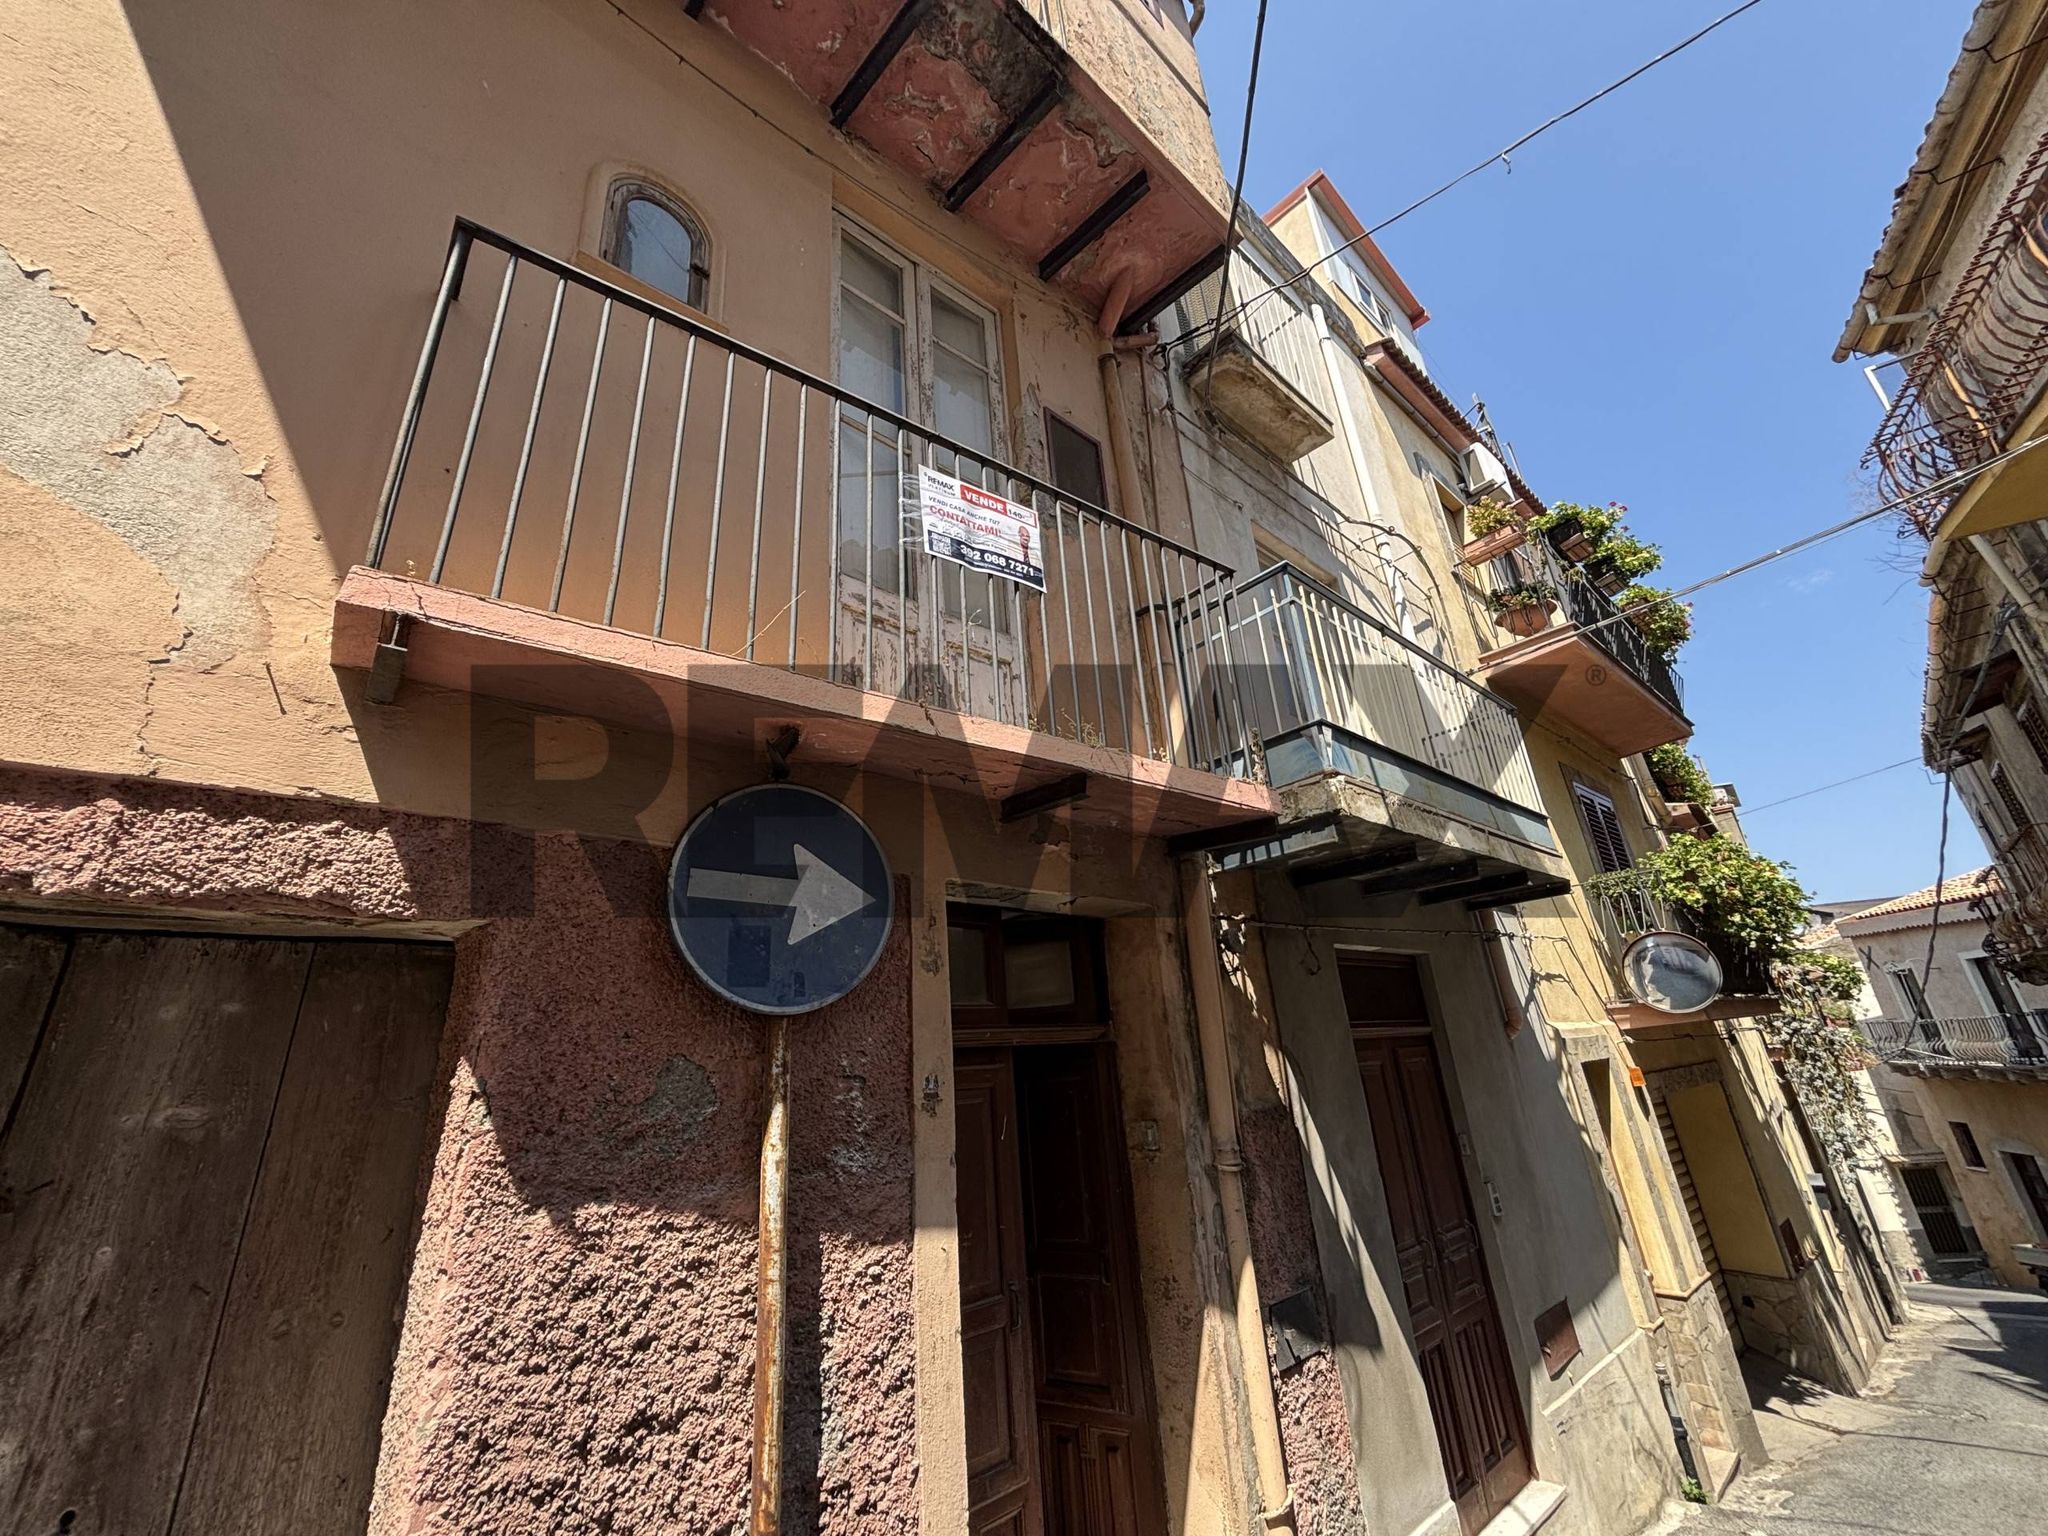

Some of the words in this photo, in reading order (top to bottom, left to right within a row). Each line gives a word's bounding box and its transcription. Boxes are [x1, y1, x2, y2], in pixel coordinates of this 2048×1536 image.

[927, 475, 955, 492] REMAX
[928, 495, 949, 507] VENDI
[949, 503, 966, 514] CASA
[966, 511, 987, 522] ANCHE
[963, 489, 1005, 513] VENDE
[959, 544, 982, 561] 392
[983, 553, 1007, 567] 068
[1008, 559, 1035, 577] 7271
